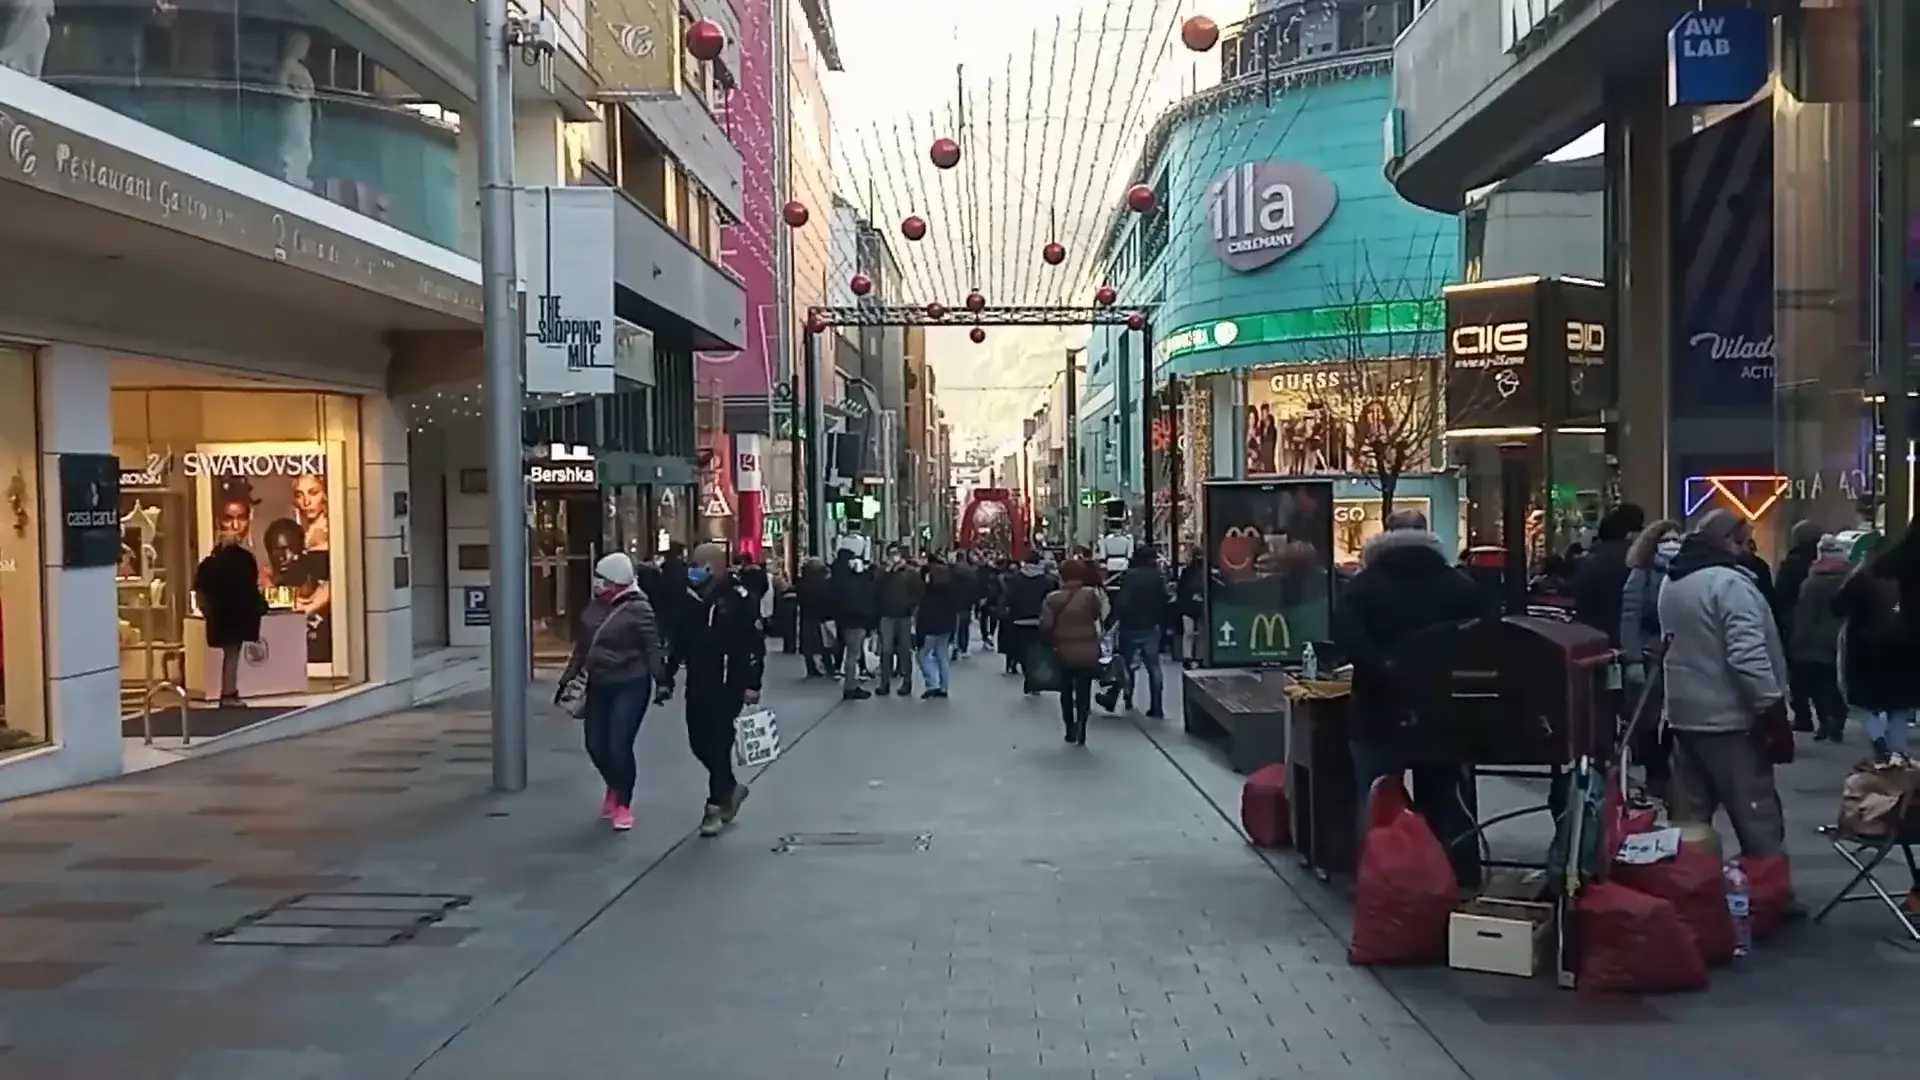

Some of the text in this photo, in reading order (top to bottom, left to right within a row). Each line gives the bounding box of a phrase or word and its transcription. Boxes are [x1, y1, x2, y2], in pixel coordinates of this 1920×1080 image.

[1684, 17, 1725, 36] AW
[1684, 38, 1730, 57] LAB
[56, 143, 152, 202] Restaurant
[1211, 162, 1294, 240] illa
[538, 294, 561, 320] THE
[538, 320, 602, 344] SHOPPING
[567, 344, 598, 368] MILE
[183, 452, 328, 477] SWAROVSKI
[531, 466, 595, 483] Bershka
[67, 508, 118, 527] casa canut
[469, 591, 485, 609] P
